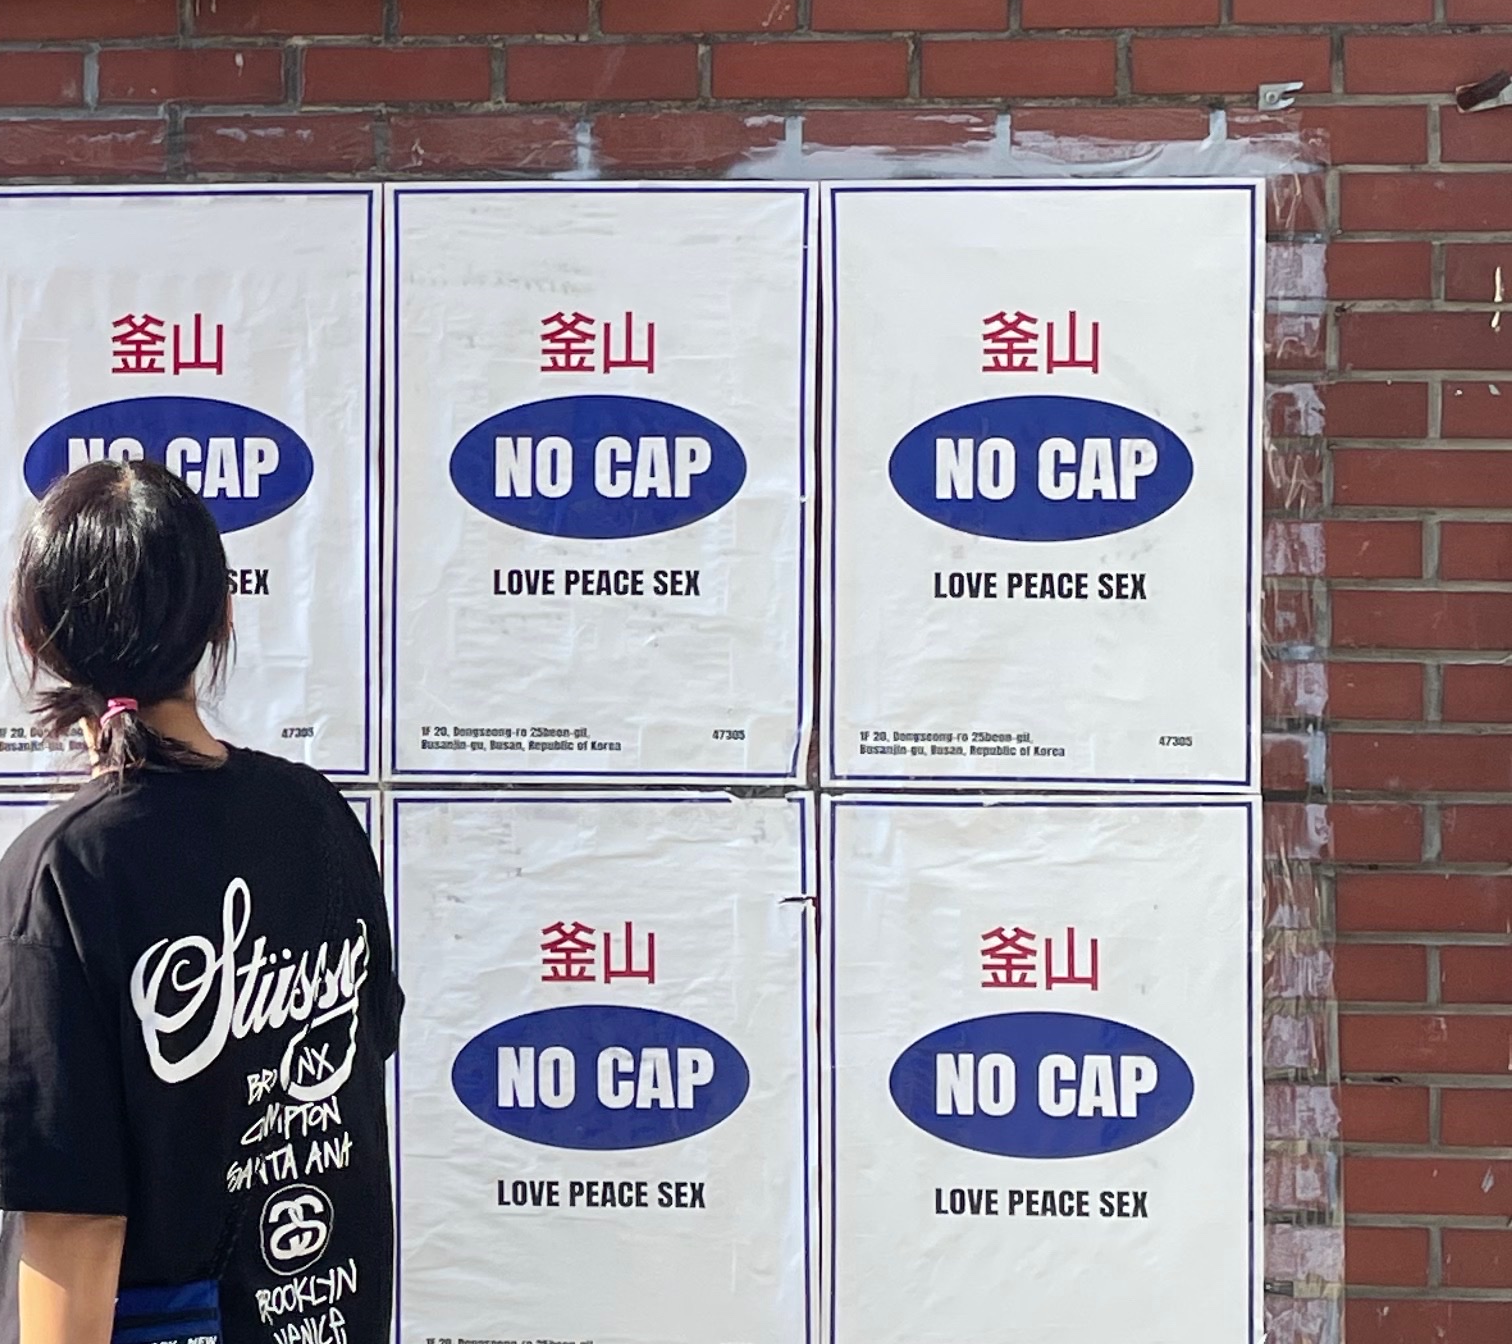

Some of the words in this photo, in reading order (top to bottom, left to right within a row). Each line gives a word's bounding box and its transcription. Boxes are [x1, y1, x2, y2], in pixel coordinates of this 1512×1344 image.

[112, 313, 224, 375] 釜山
[541, 311, 655, 374] 釜山
[983, 311, 1100, 374] 釜山
[165, 437, 279, 499] CAP
[495, 436, 572, 498] NO
[595, 436, 711, 498] CAP
[936, 438, 1015, 500] NO
[1038, 437, 1157, 500] CAP
[493, 569, 555, 596] LOVE
[564, 569, 644, 596] PEACE
[653, 570, 700, 596] SEX
[934, 572, 997, 599] LOVE
[1007, 572, 1089, 600] PEACE
[1098, 572, 1147, 600] SEX
[541, 921, 656, 983] 釜山
[983, 927, 1099, 991] 釜山
[498, 1047, 575, 1108] NO
[598, 1047, 714, 1109] CAP
[936, 1053, 1016, 1116] NO
[1038, 1054, 1157, 1117] CAP
[497, 1179, 560, 1207] LOVE
[569, 1180, 649, 1208] PEACE
[657, 1181, 706, 1209] SEX
[935, 1188, 999, 1216] LOVE
[1008, 1189, 1090, 1217] PEACE
[1099, 1191, 1148, 1218] SEX
